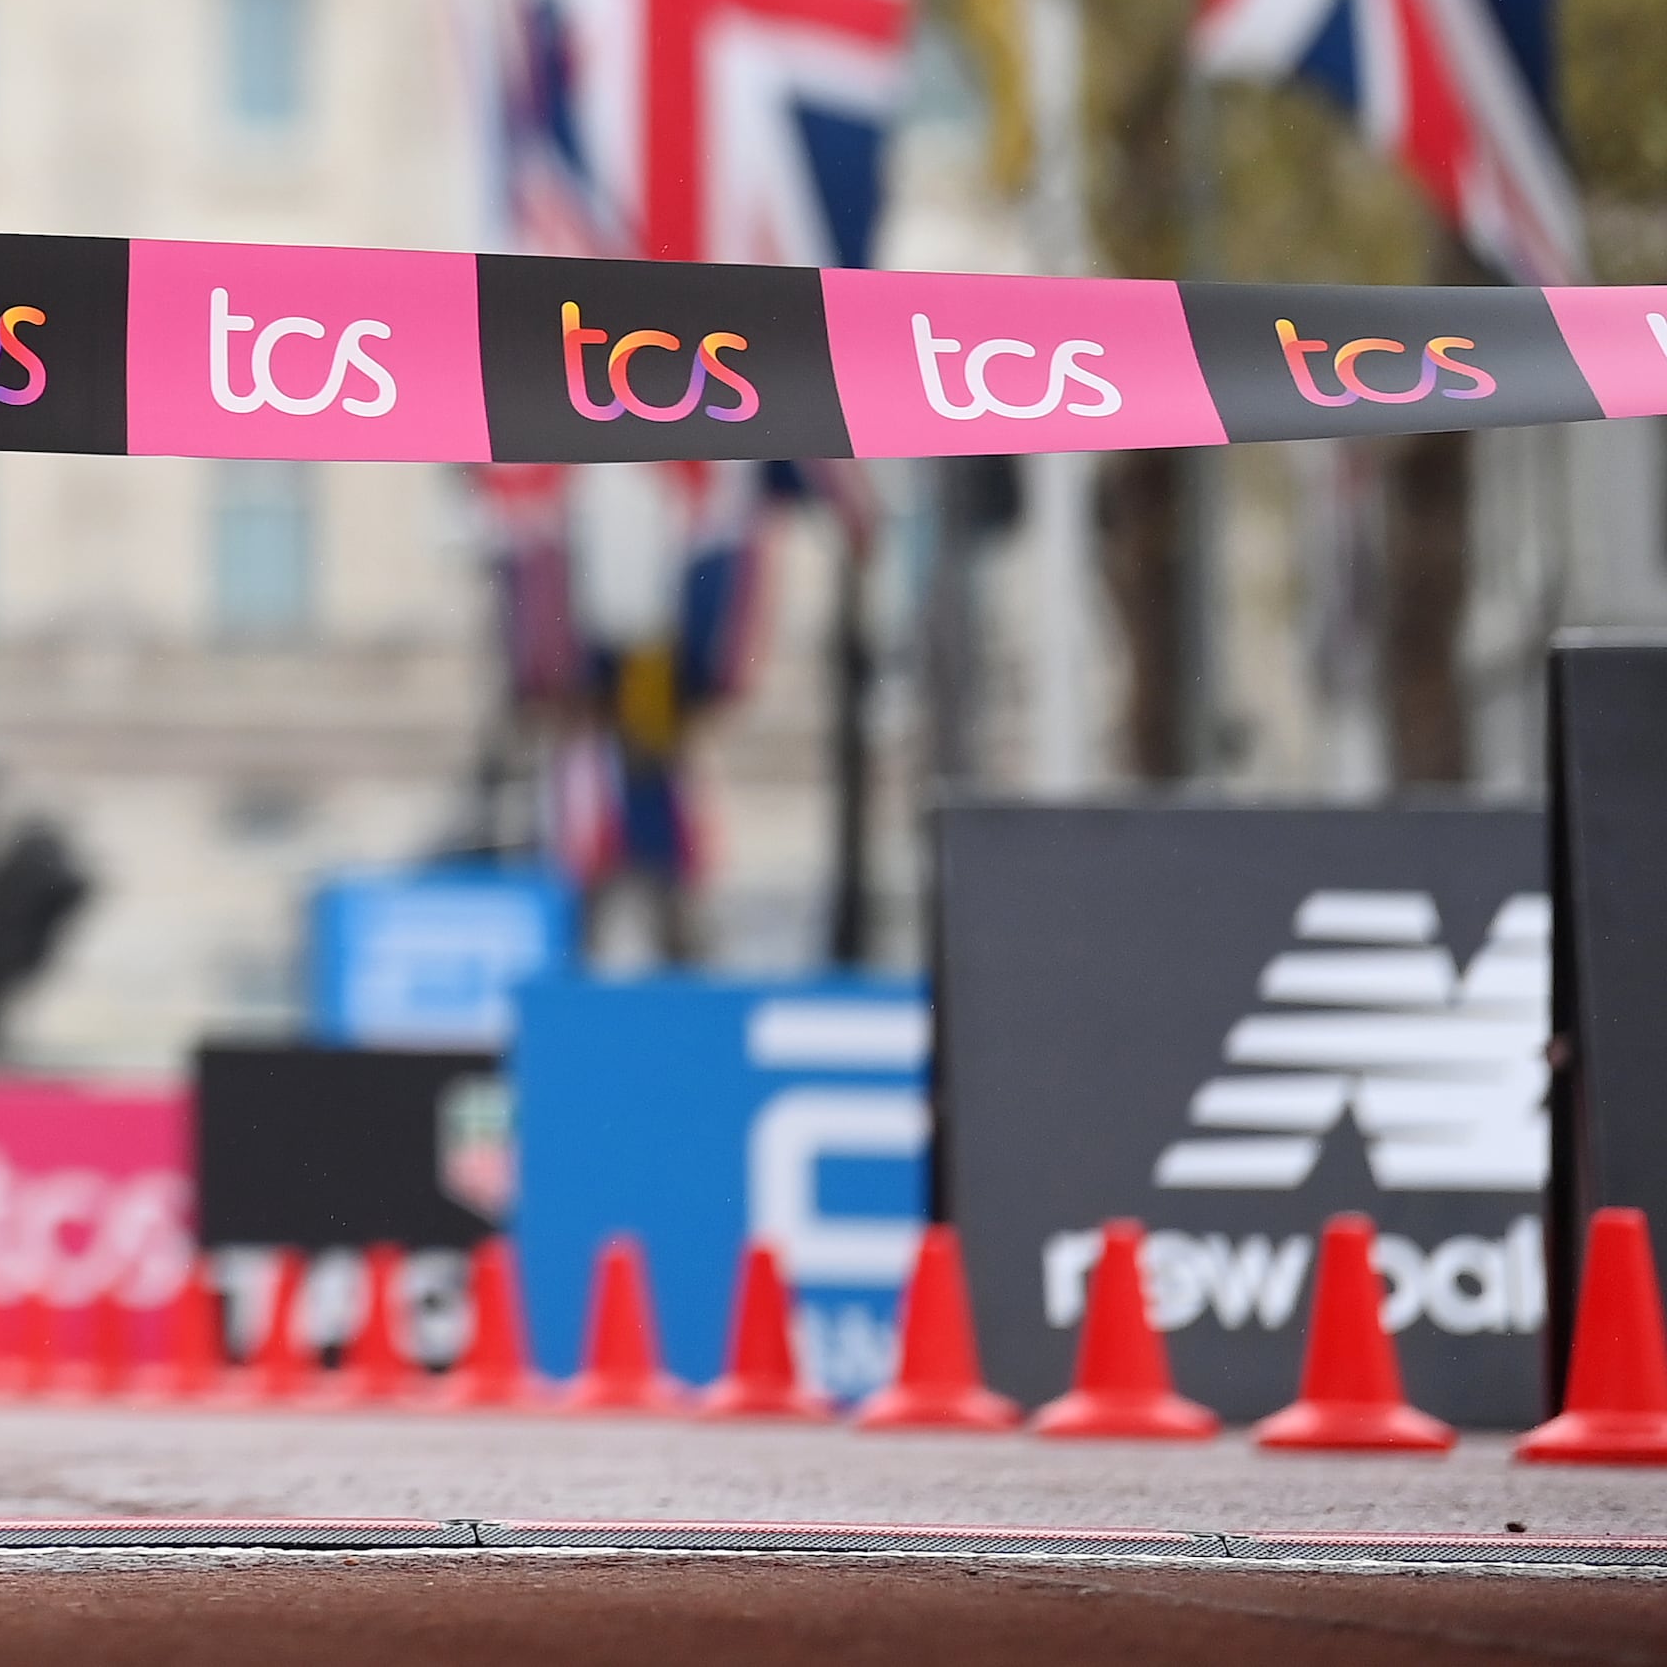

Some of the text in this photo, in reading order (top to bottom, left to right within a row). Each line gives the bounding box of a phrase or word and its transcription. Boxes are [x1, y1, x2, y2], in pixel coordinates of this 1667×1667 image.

[208, 287, 398, 419] tcs
[560, 300, 760, 425] tcs
[911, 312, 1124, 422] tcs
[1274, 318, 1497, 409] tcs
